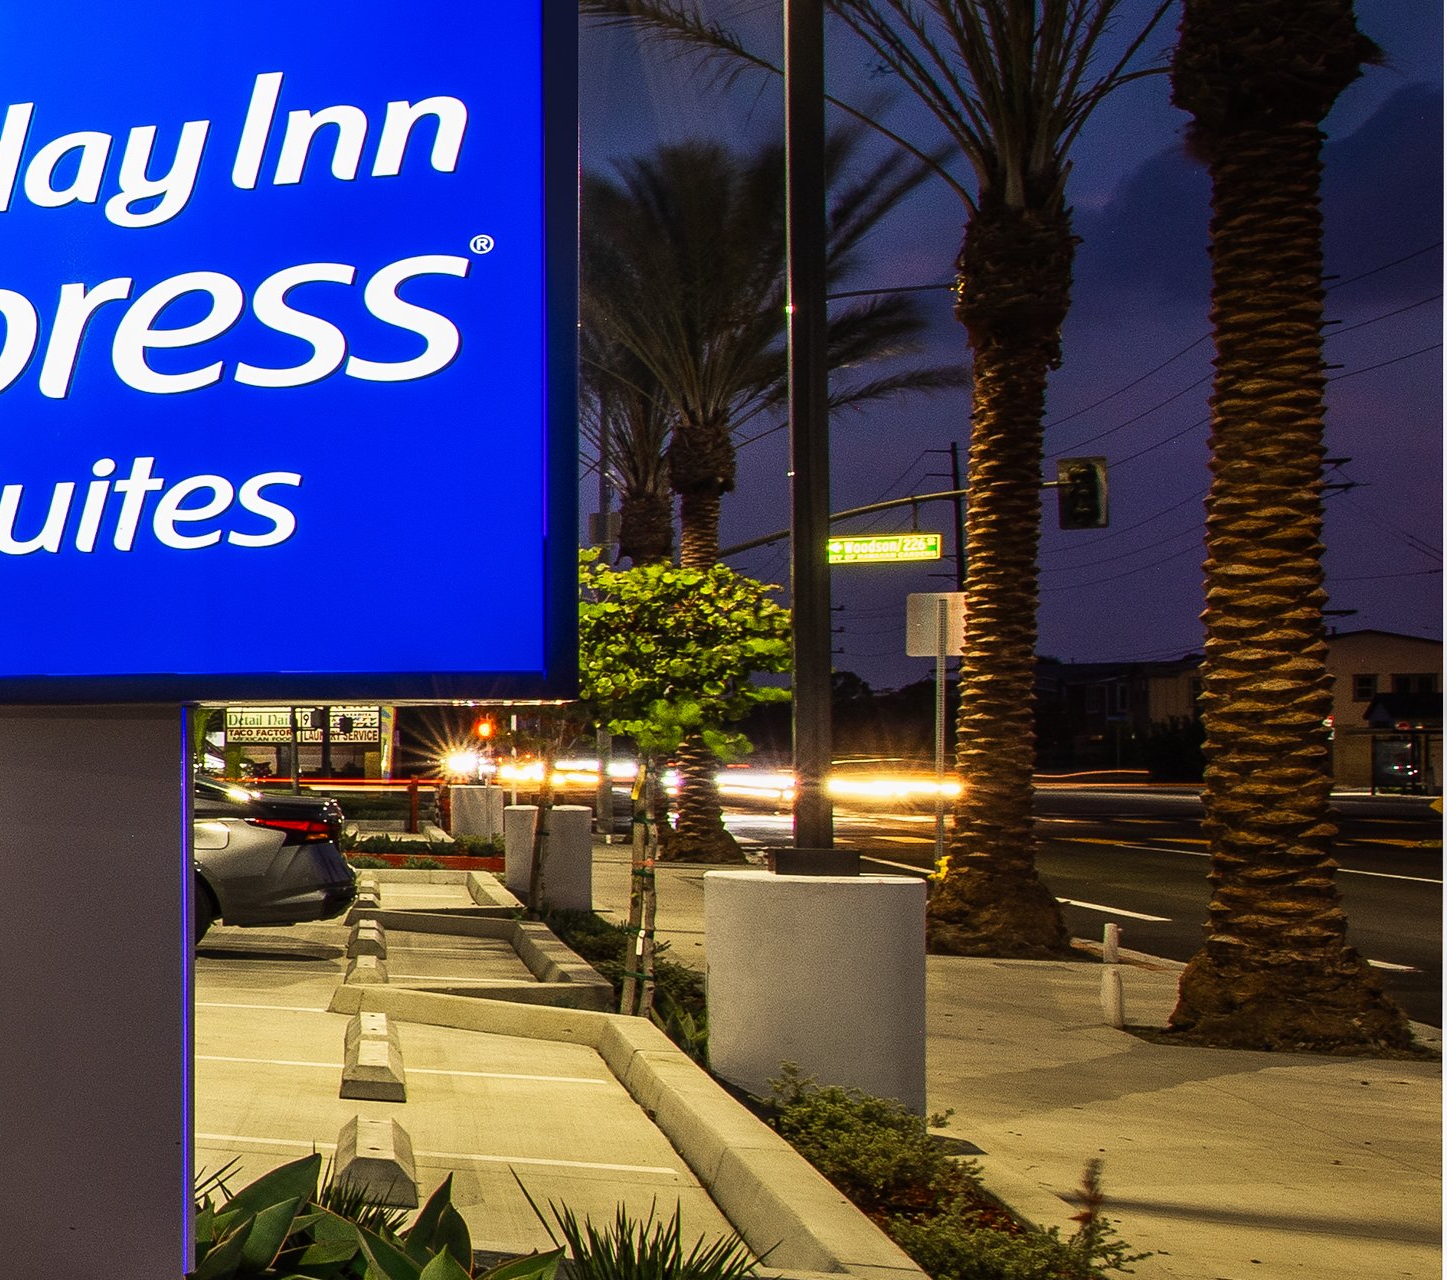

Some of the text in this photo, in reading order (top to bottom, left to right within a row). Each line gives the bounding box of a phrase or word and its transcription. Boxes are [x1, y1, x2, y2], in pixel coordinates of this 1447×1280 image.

[231, 71, 468, 190] Inn
[228, 729, 293, 737] TACO FACTOR
